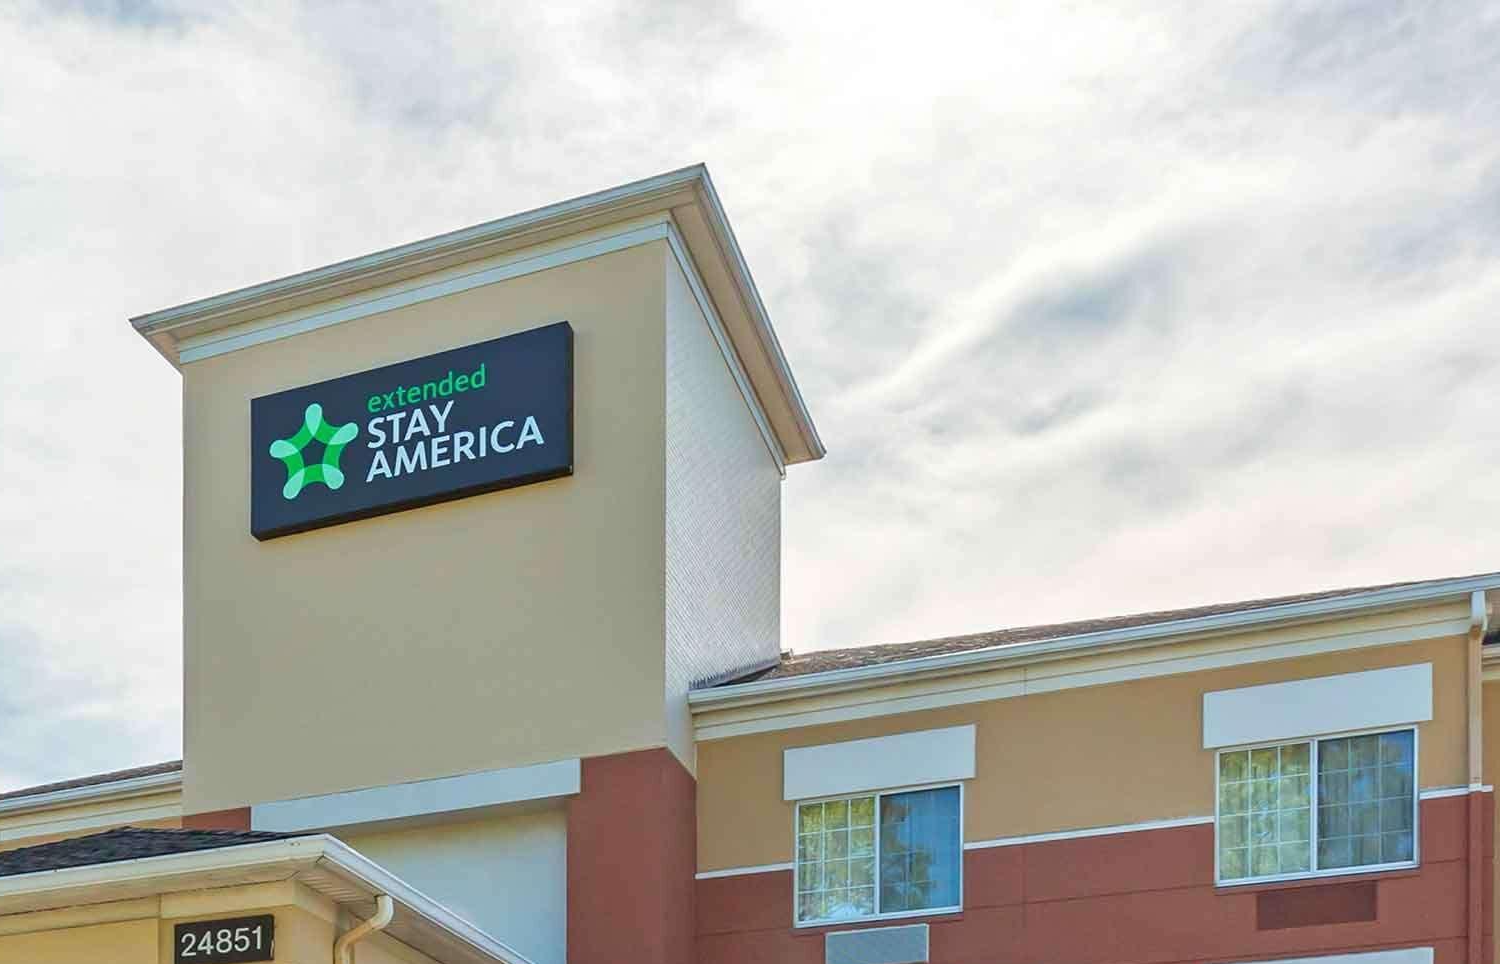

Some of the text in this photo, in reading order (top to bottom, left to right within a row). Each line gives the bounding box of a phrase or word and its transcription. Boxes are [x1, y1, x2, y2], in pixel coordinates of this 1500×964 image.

[367, 363, 487, 413] extended
[367, 400, 455, 448] STAY
[366, 416, 544, 482] AMERICA
[180, 925, 262, 957] 24851
